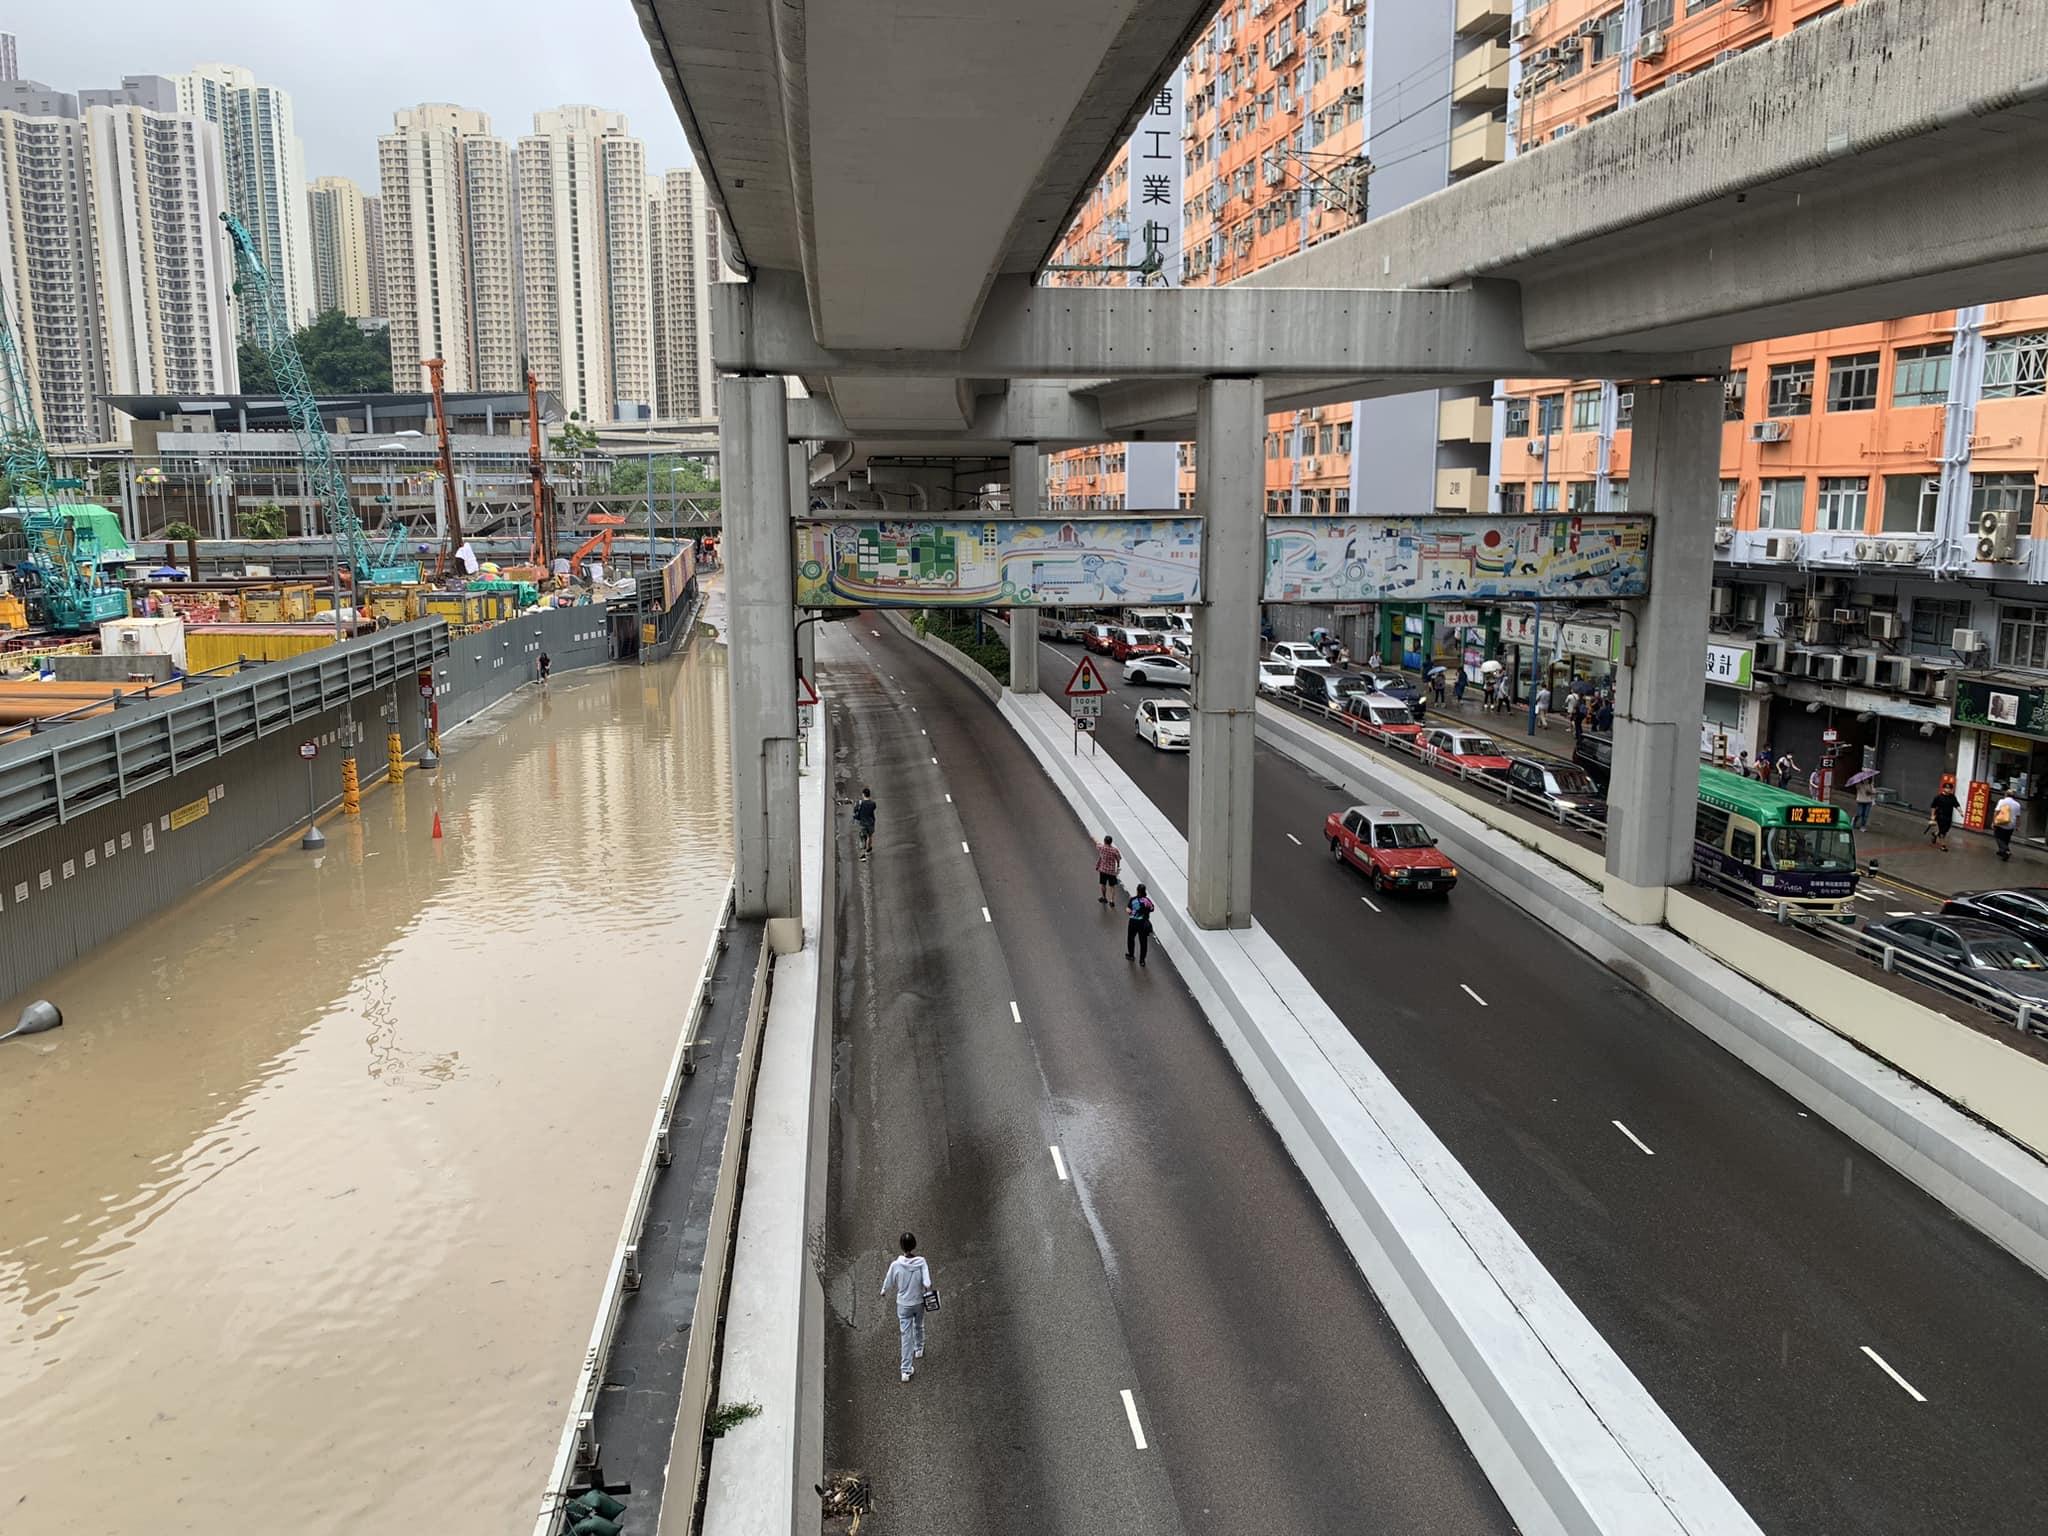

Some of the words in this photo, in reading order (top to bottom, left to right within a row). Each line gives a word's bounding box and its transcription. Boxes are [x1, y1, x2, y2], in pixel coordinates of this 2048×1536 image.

[1143, 88, 1172, 286] 工業中
[1791, 808, 1803, 821] 102
